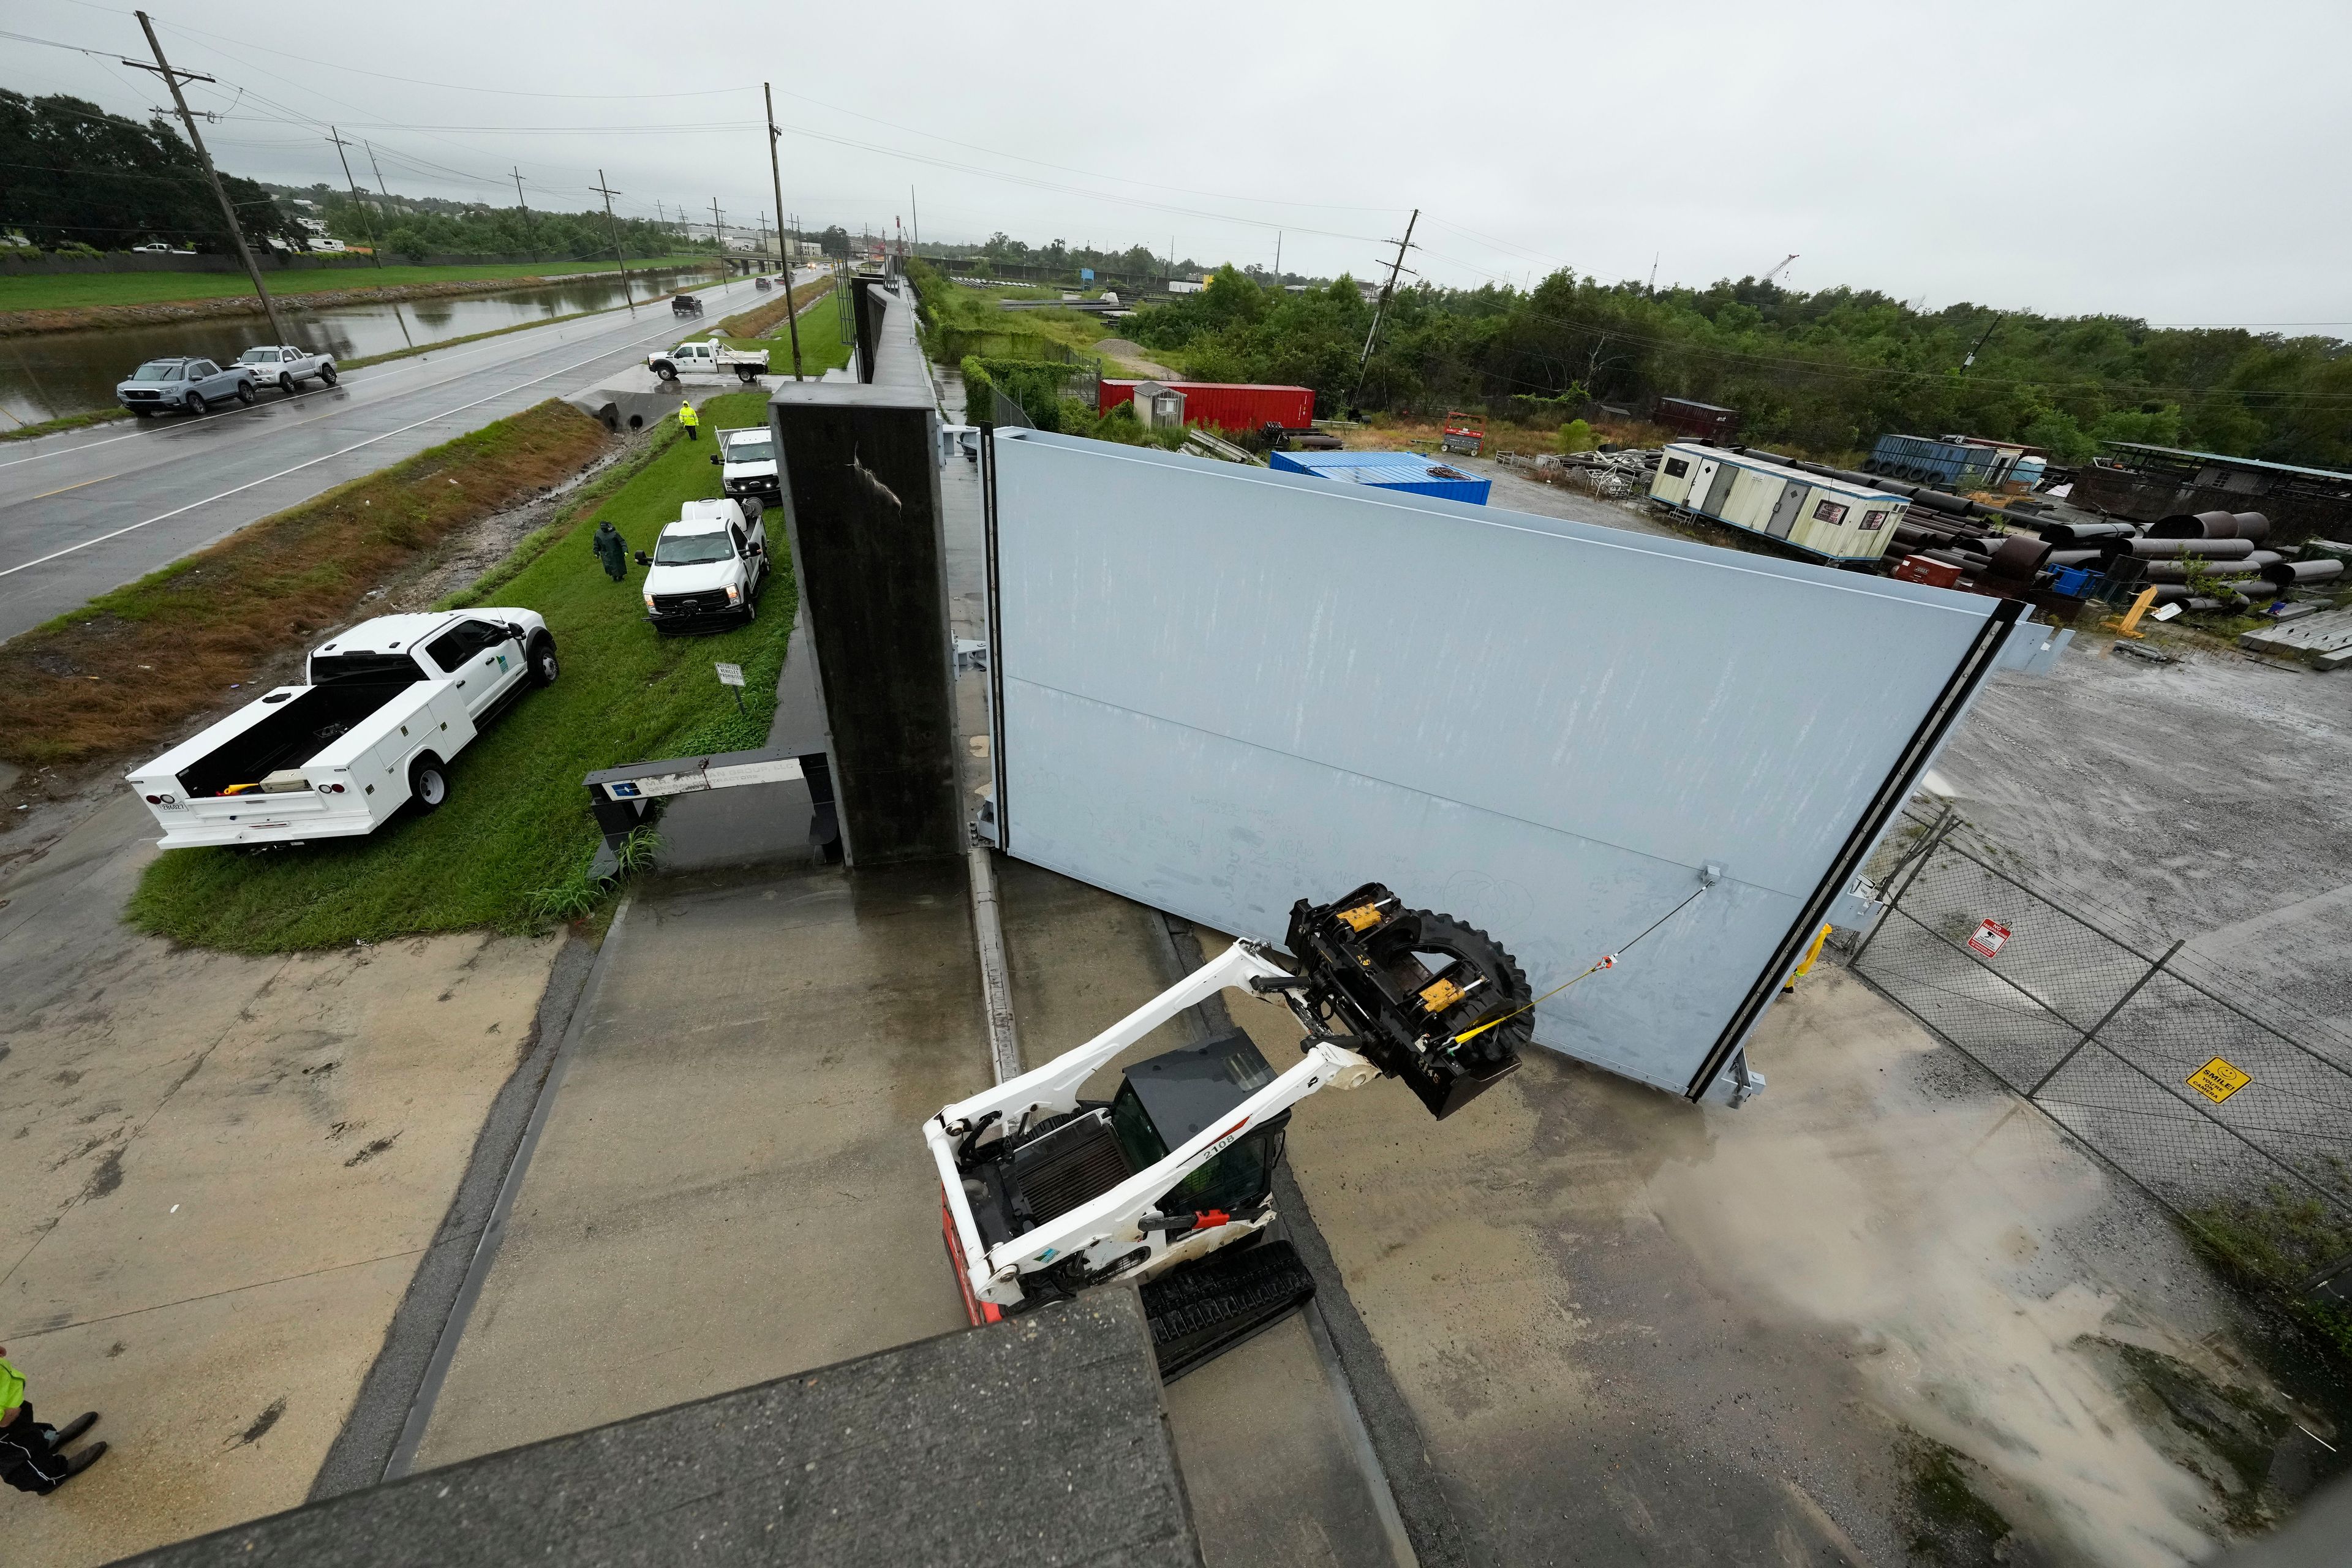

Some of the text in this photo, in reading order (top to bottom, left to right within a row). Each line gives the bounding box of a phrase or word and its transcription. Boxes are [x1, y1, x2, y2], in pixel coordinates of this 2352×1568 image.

[1983, 922, 2008, 939] TRESPASSING
[2203, 1069, 2235, 1091] SMILE!
[2203, 1077, 2224, 1093] YOU'RE
[2193, 1081, 2218, 1099] CAMERA
[1204, 1135, 1235, 1159] 2108
